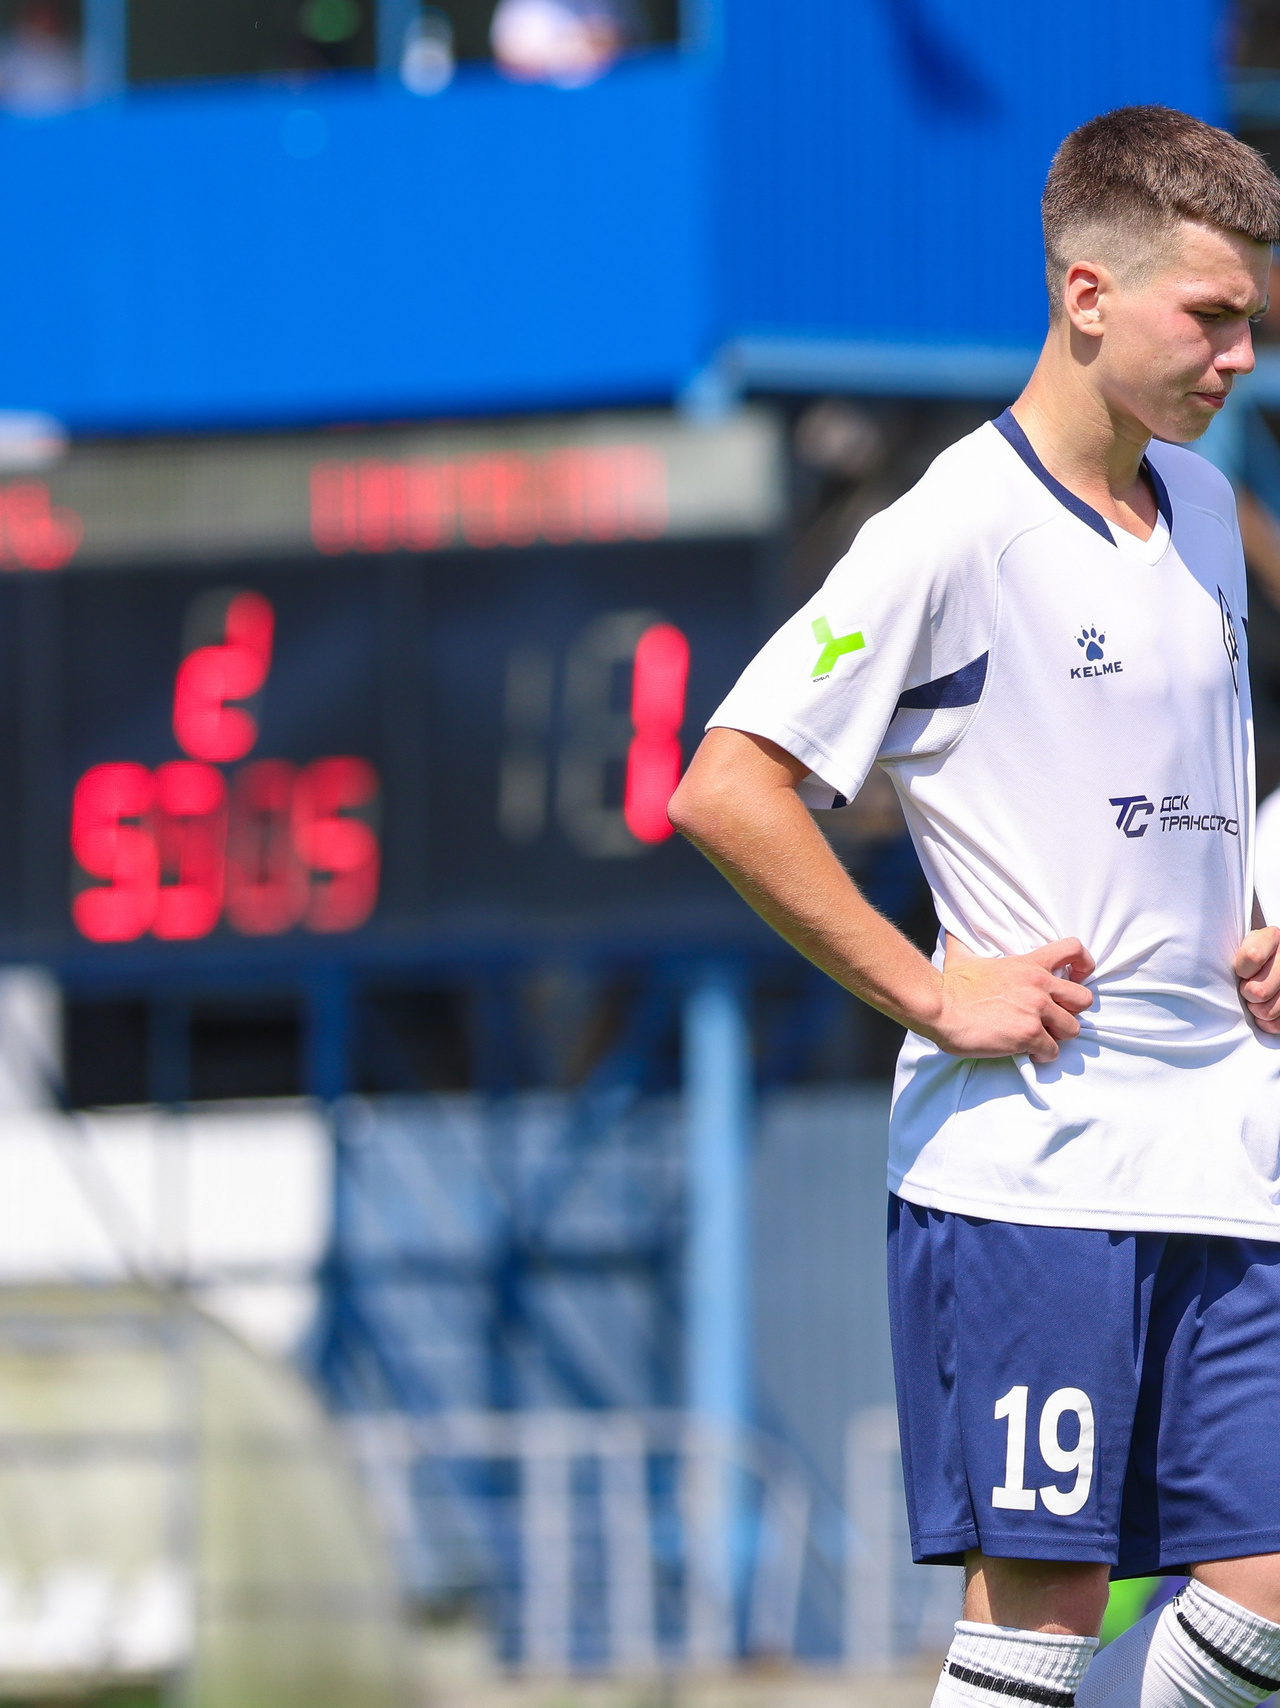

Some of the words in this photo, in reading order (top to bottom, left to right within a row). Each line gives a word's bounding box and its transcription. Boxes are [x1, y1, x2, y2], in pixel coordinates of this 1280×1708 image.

[1070, 661, 1123, 679] KELME
[1160, 794, 1190, 813] ДСК
[991, 1385, 1095, 1516] 19
